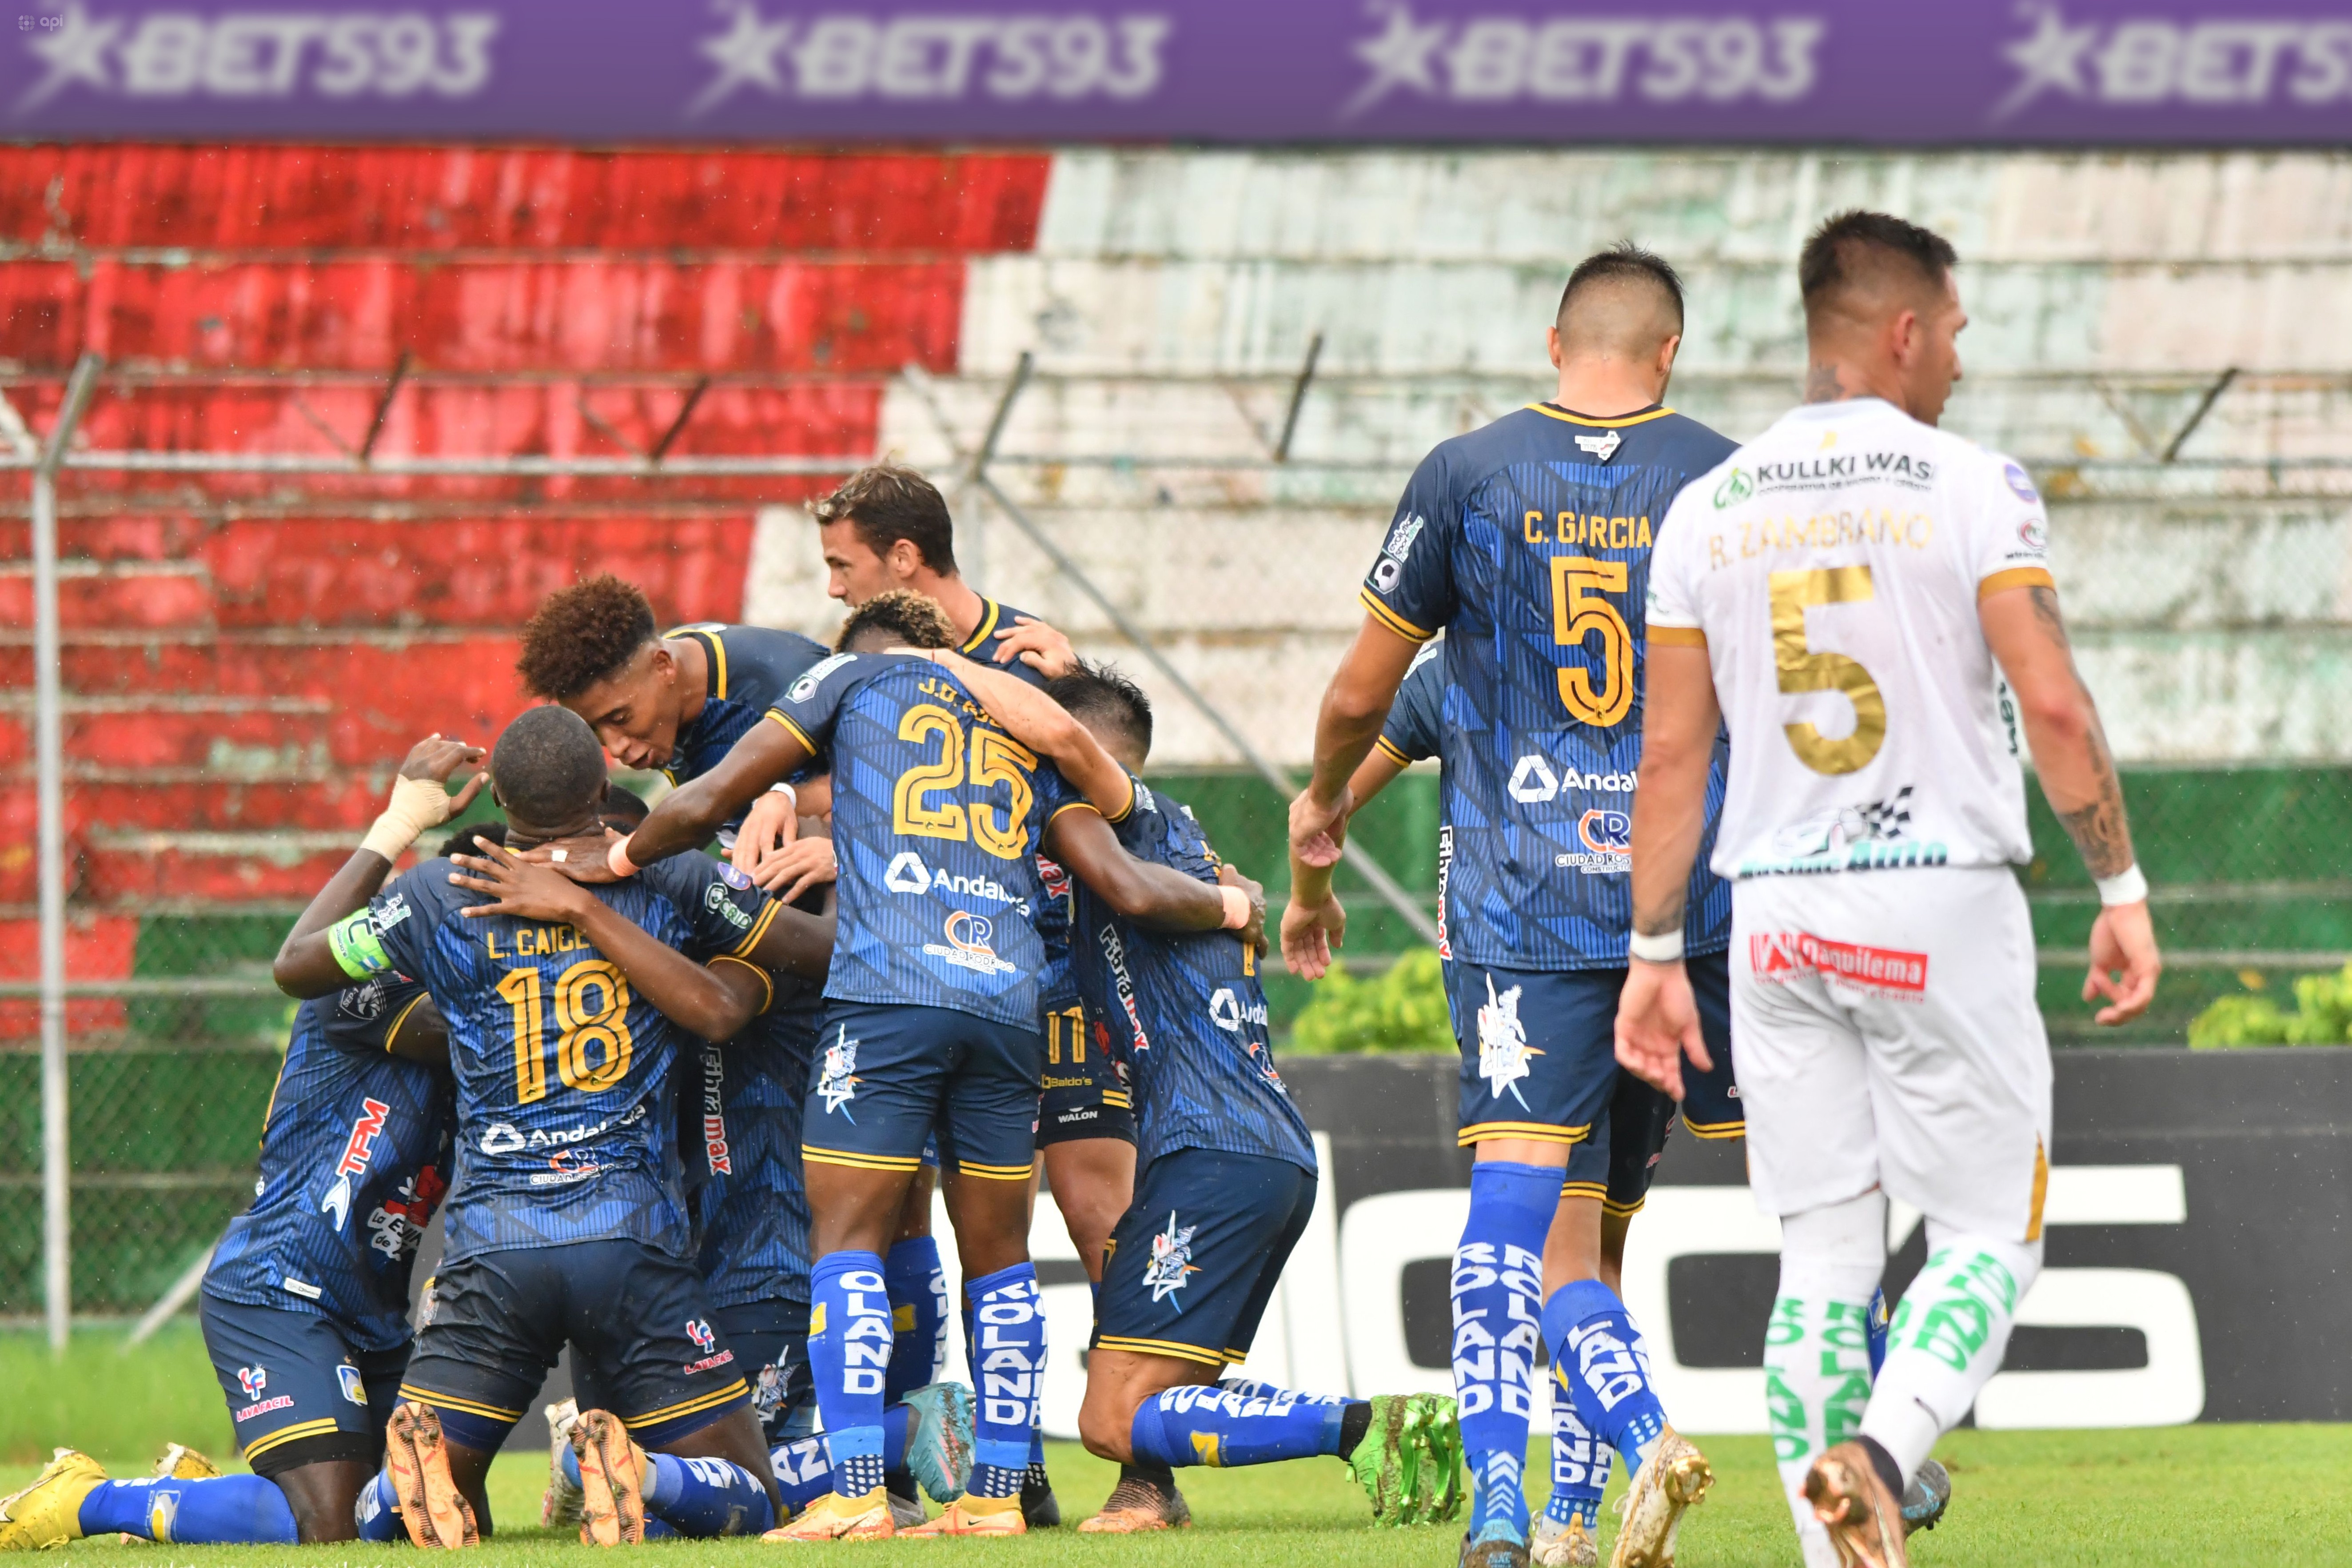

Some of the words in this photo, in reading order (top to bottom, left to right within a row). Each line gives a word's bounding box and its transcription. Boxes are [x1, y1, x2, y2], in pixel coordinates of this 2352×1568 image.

[1758, 456, 1856, 483] KULLKI
[1866, 452, 1933, 480] WAS
[1524, 511, 1550, 544] C.
[1557, 511, 1652, 549] GARCIA
[1709, 536, 1734, 570] R.
[1740, 508, 1933, 559] ZAMBRANO
[1550, 556, 1634, 727] 5
[1768, 566, 1887, 776] 5
[893, 704, 1039, 860] 25
[1556, 854, 1603, 866] CIUDAD
[488, 931, 511, 959] L.
[924, 945, 966, 959] CIUDAD
[969, 953, 1015, 973] RODRIGO
[496, 959, 634, 1105] 18
[1058, 1110, 1098, 1123] WALON
[336, 1097, 391, 1177] TPM
[375, 1235, 391, 1248] de
[1451, 1241, 1498, 1420] ROLAND
[236, 1395, 295, 1422] LAVAFACIL
